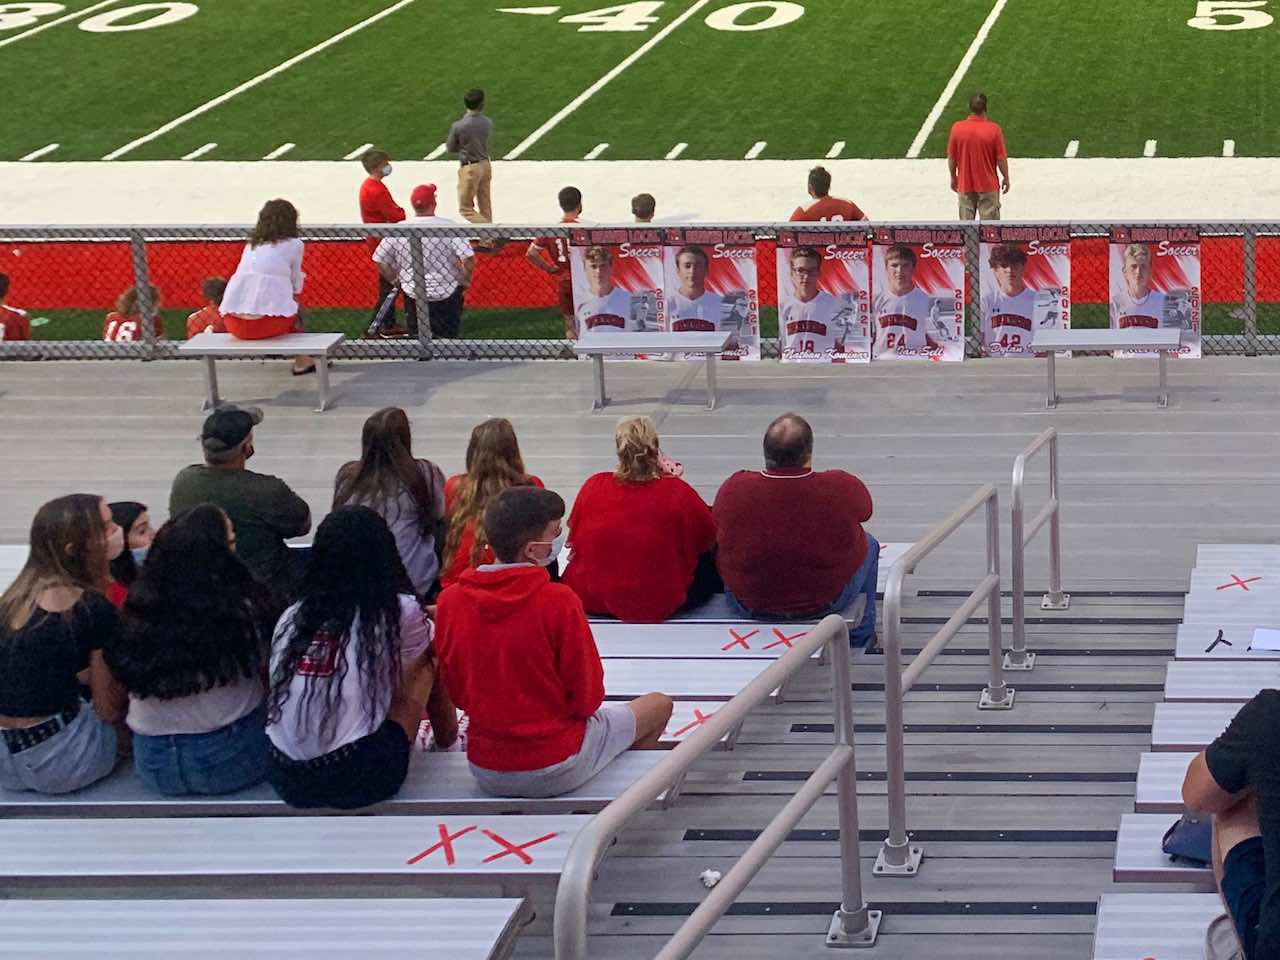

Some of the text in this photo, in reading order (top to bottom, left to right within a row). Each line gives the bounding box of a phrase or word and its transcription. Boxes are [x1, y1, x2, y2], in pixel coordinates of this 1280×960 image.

[557, 0, 805, 32] 40
[619, 243, 661, 257] Soccer
[712, 243, 753, 258] Soccer
[824, 244, 866, 259] Soccer
[920, 242, 962, 258] Soccer
[1027, 241, 1068, 255] Soccer
[1157, 241, 1198, 256] Soccer
[748, 290, 757, 336] 2021
[860, 290, 868, 336] 2021
[954, 288, 963, 336] 2021
[1191, 286, 1199, 334] 2021
[104, 320, 137, 343] 16
[919, 344, 944, 357] Sell
[989, 342, 1023, 354] Dylan
